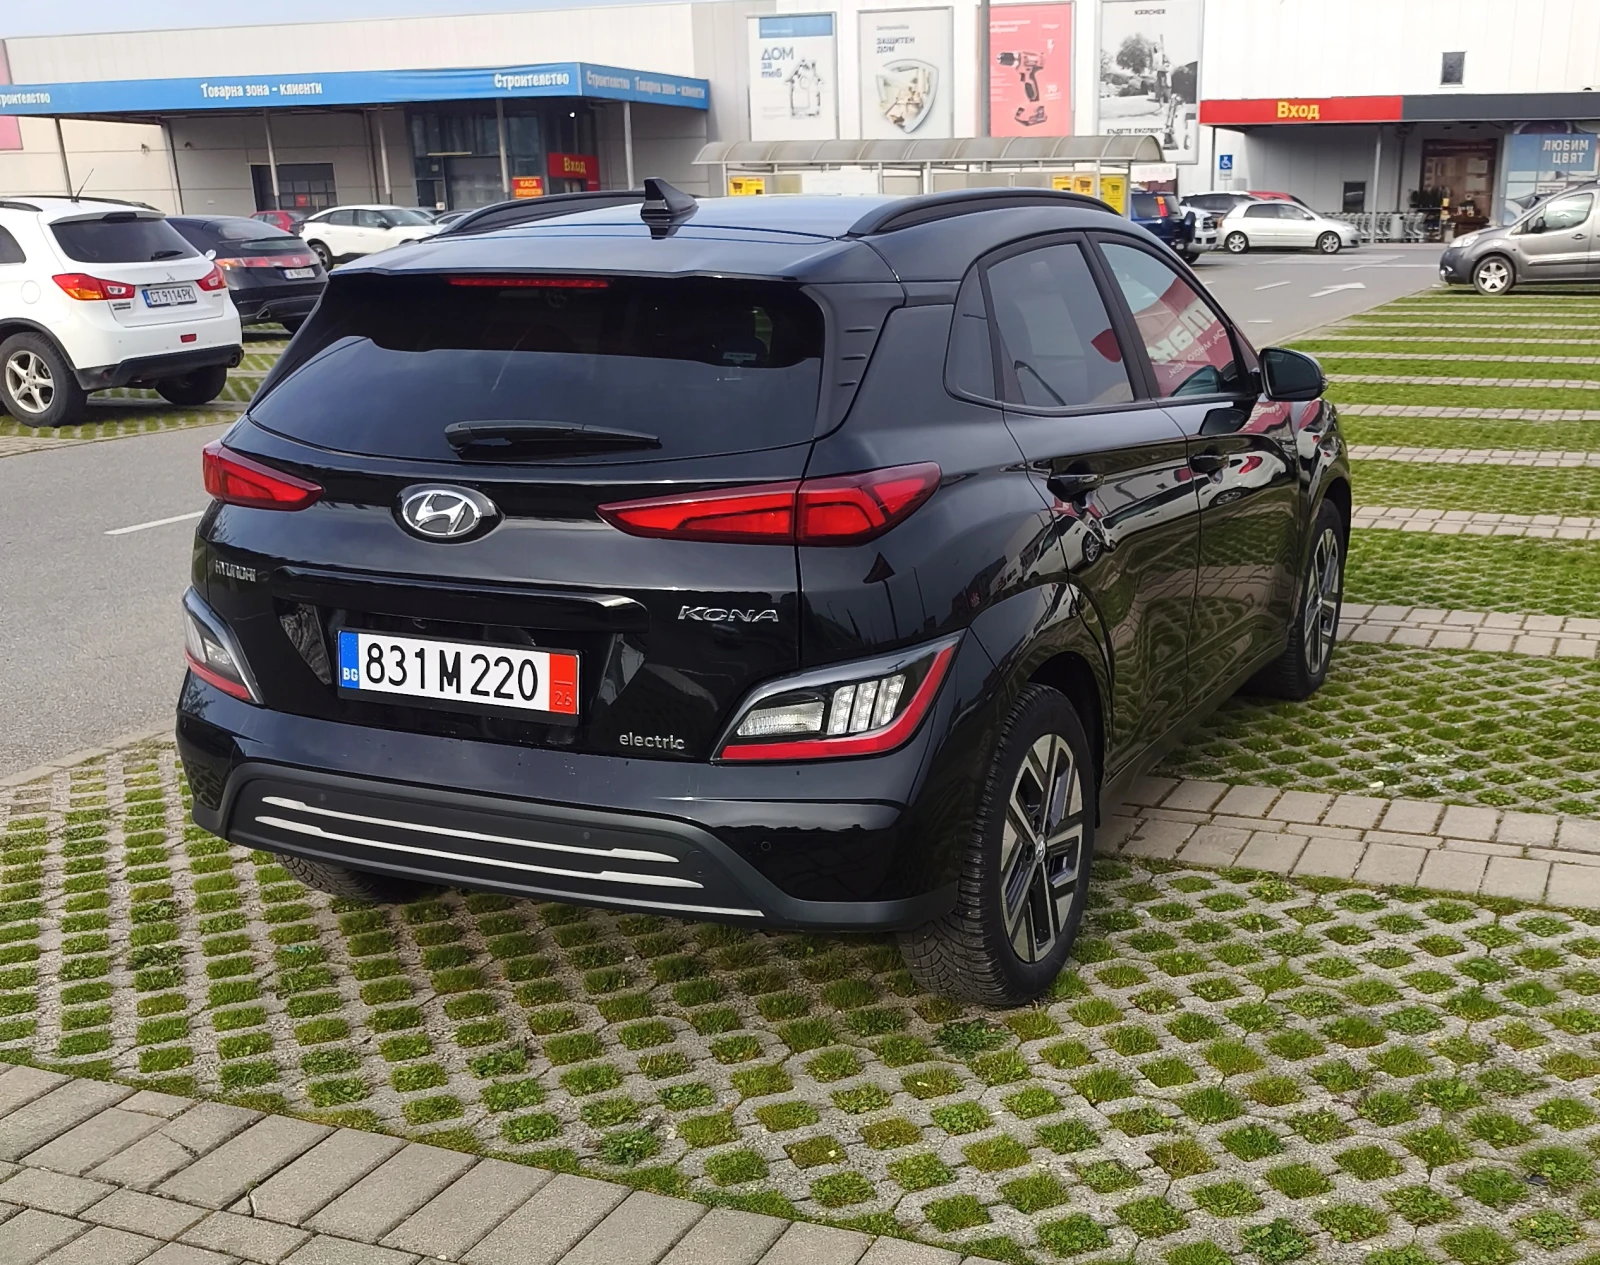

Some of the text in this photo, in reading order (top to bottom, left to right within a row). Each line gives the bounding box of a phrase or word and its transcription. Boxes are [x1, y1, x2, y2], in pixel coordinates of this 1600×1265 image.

[761, 46, 794, 61] ДОМ
[494, 71, 569, 90] Строителство
[200, 82, 244, 100] Товарна
[245, 84, 270, 97] зона
[279, 82, 323, 96] клиенти
[1277, 101, 1320, 120] Вход
[1542, 139, 1589, 151] ЛЮБИМ
[563, 157, 587, 174] Вход
[1552, 152, 1585, 166] ЦВЯТ
[215, 560, 256, 582] HYUNDAI
[677, 605, 779, 622] KONA
[343, 667, 358, 682] BG
[619, 731, 685, 750] electric
